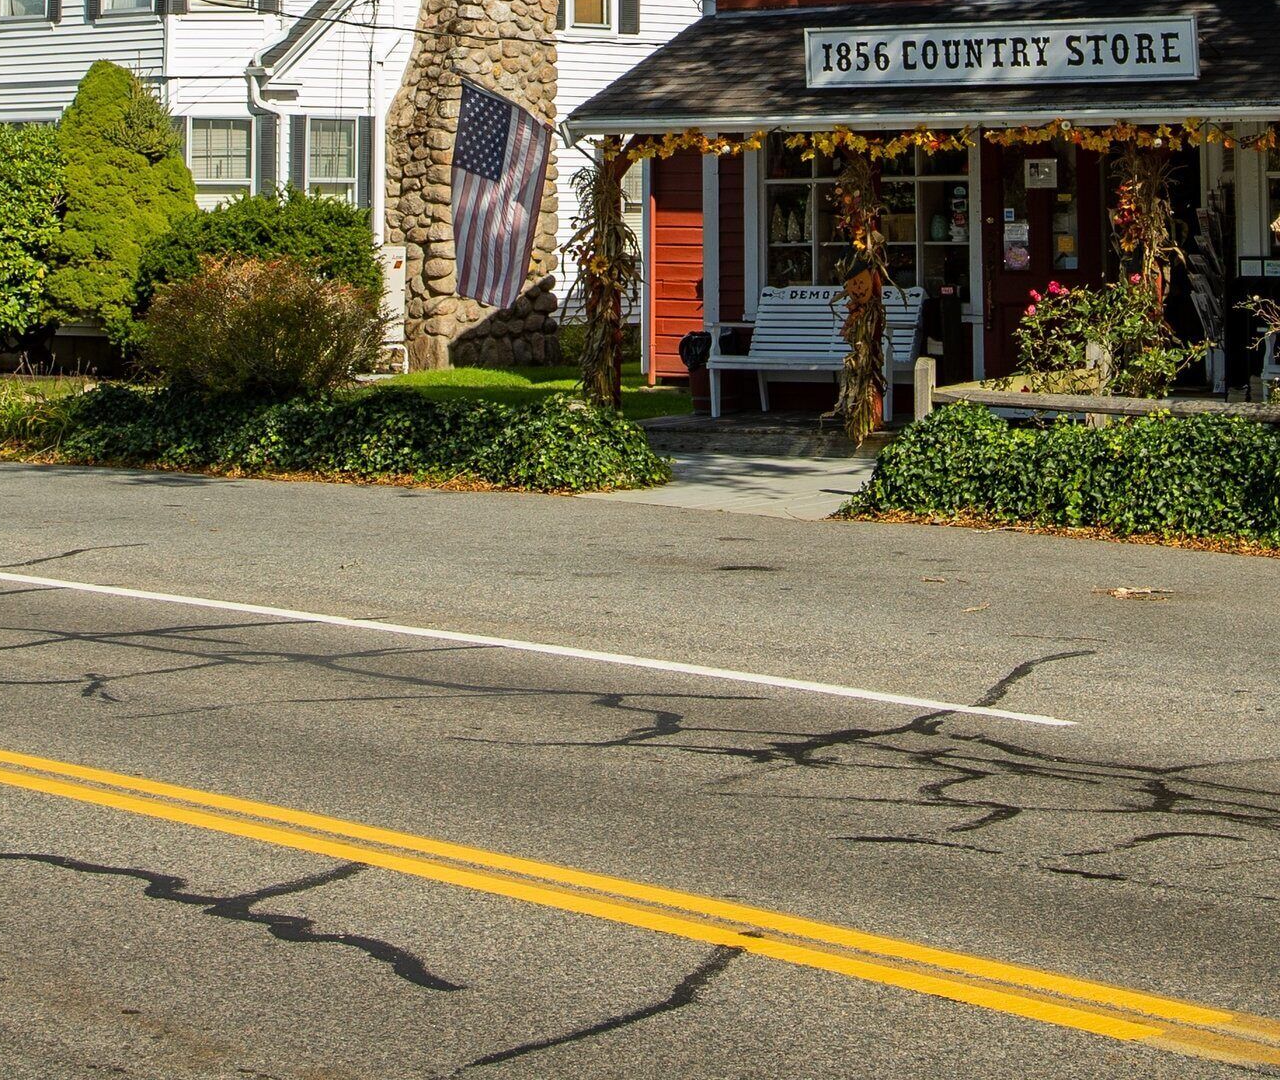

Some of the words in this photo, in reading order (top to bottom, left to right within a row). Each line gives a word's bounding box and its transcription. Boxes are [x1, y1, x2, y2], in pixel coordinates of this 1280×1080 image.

[822, 41, 891, 72] 1856
[901, 36, 1051, 71] COUNTRY
[1065, 32, 1182, 67] STORE
